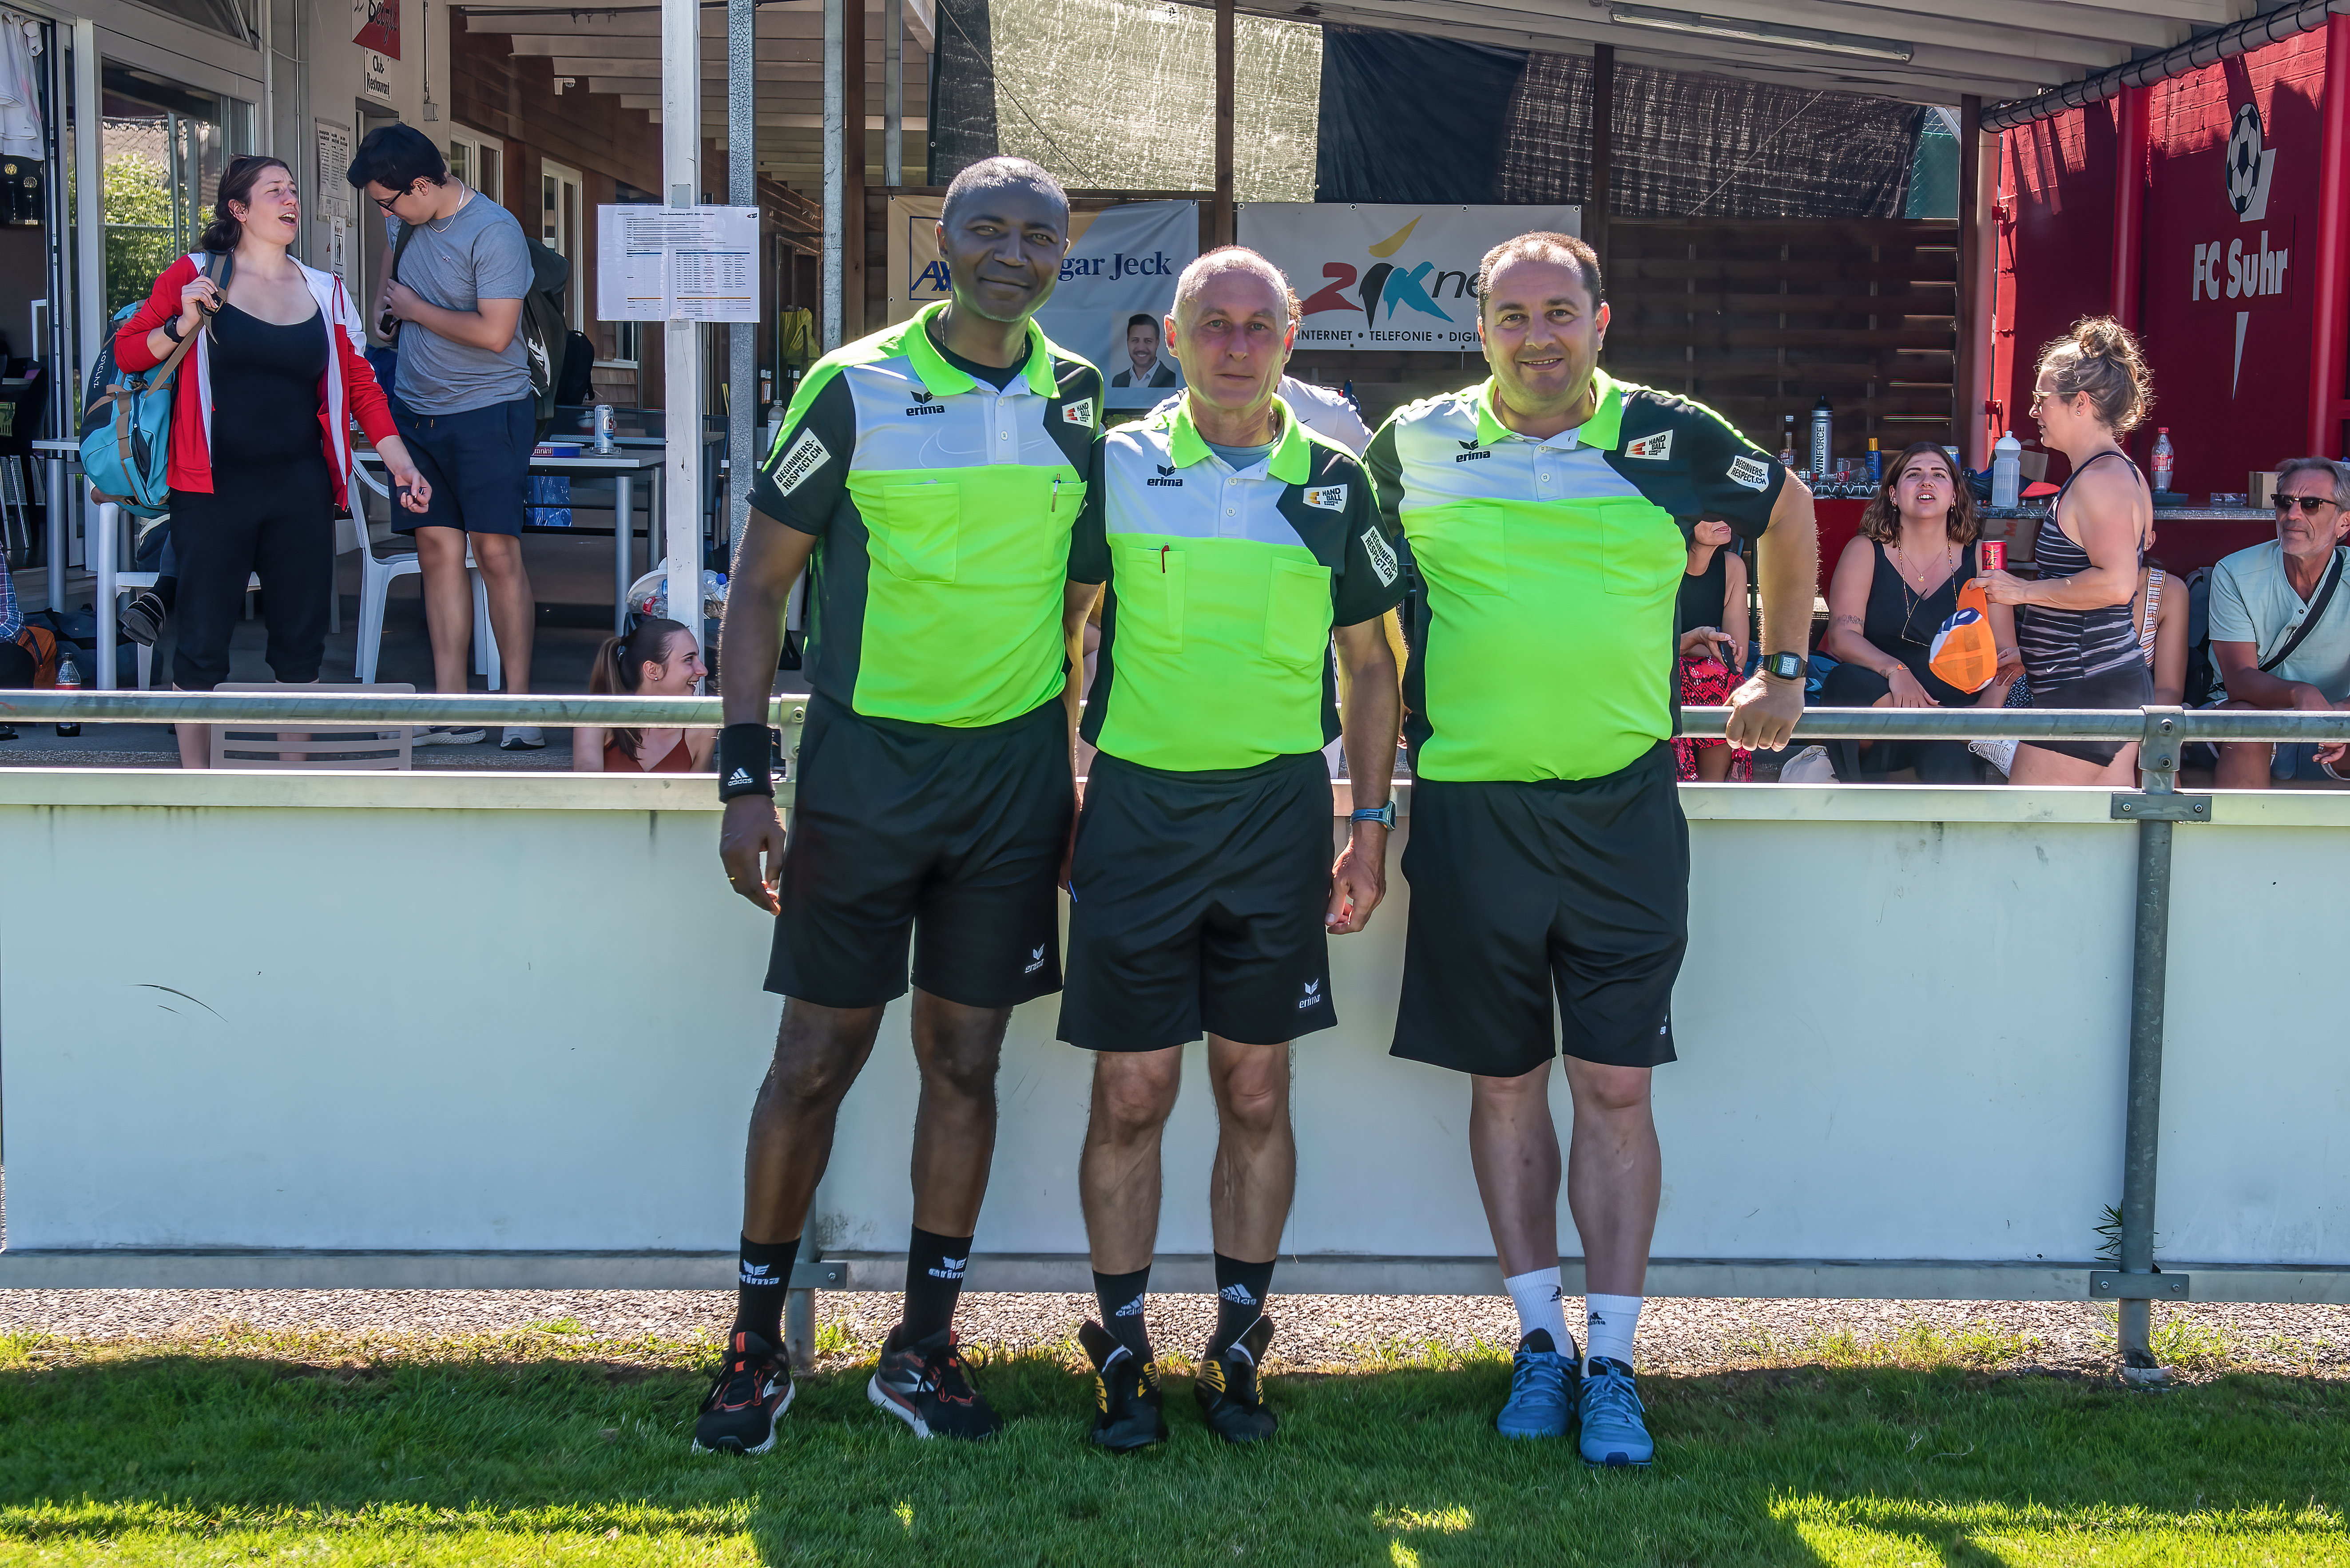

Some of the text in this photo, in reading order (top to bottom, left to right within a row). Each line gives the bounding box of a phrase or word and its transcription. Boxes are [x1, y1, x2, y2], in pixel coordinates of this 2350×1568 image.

[1109, 251, 1172, 280] Jeck
[2193, 230, 2288, 301] FC Suhr
[1297, 330, 1353, 341] INTERNET
[1370, 331, 1432, 341] TELEFONIE
[906, 404, 945, 416] erima
[1649, 435, 1666, 445] HAND
[1814, 425, 1825, 475] WINFORCE
[775, 440, 815, 483] BEGINNERS-
[782, 445, 823, 490] RESPECT.CH
[1456, 451, 1491, 463] erima
[1147, 477, 1183, 487] erima
[1731, 467, 1767, 485] RESPECT.CH
[1322, 487, 1341, 496] HAND
[1365, 536, 1394, 580] RESPECT.CH
[1370, 529, 1397, 574] BEGINNERS-
